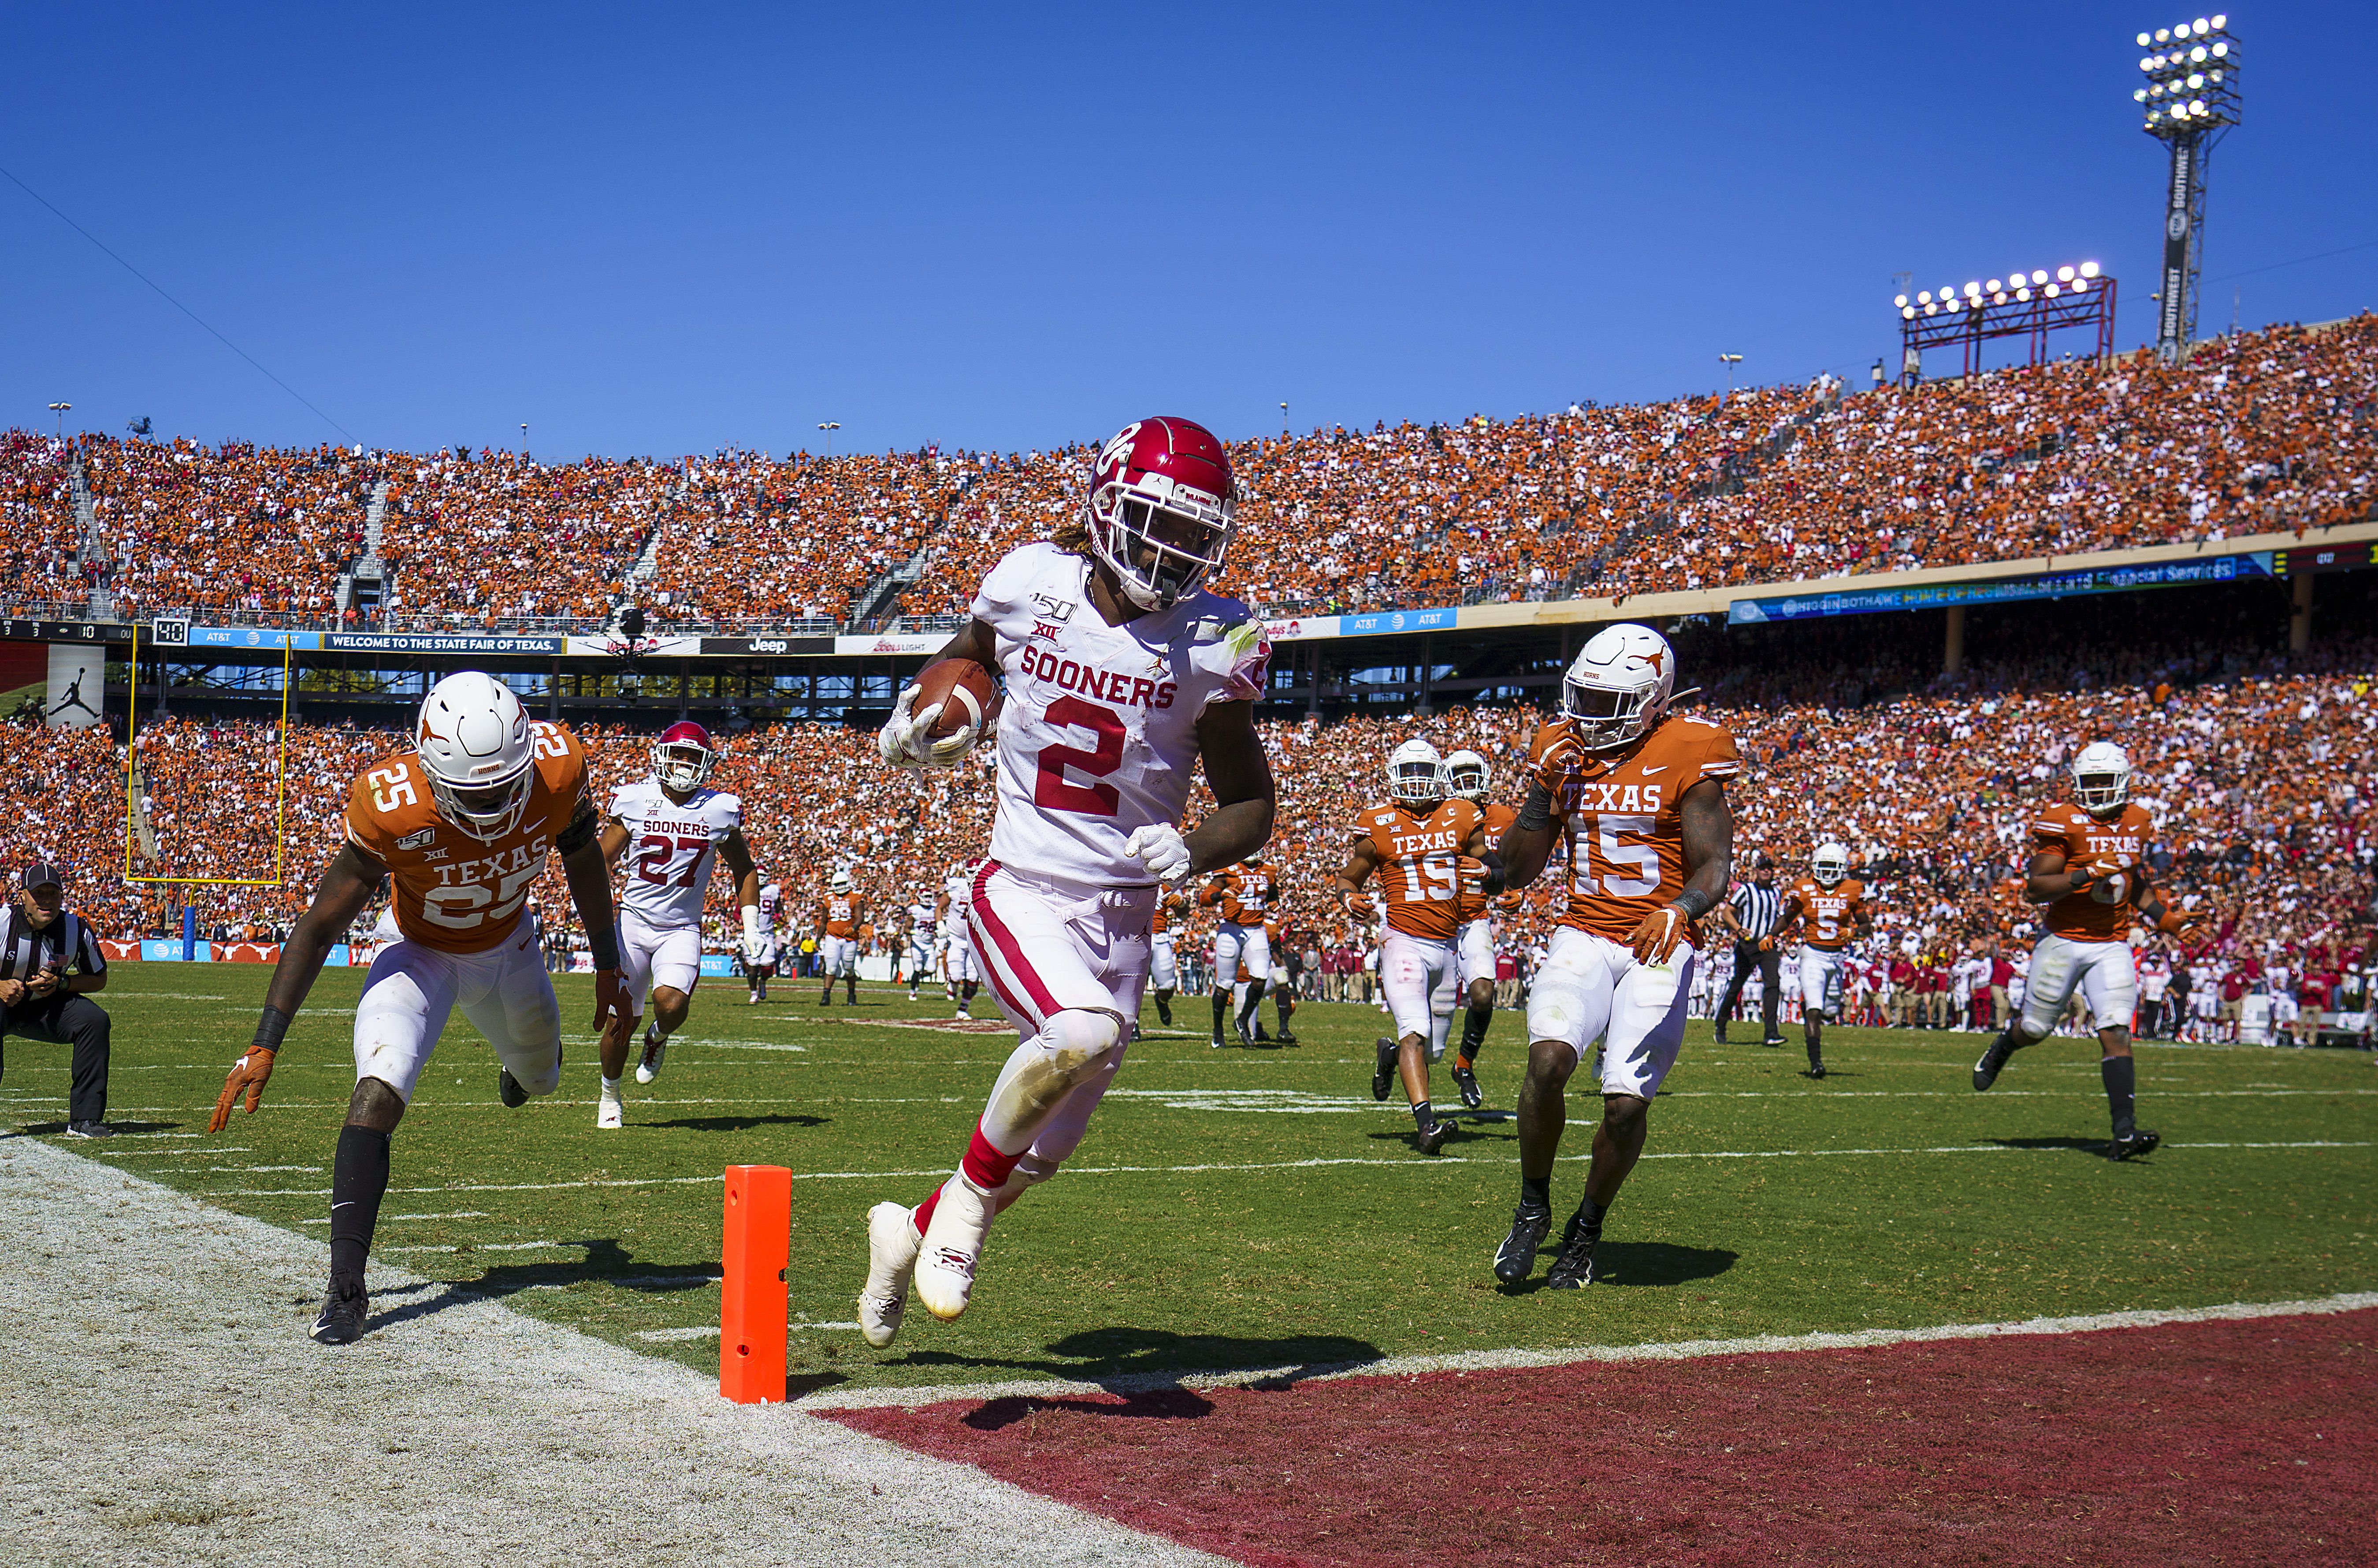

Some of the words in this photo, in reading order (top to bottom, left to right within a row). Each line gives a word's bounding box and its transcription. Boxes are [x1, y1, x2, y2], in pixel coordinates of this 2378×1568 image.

[2163, 267, 2180, 337] SOUTHWEST
[1354, 619, 1377, 629] AT&T
[1418, 613, 1442, 625] AT&T
[5, 626, 10, 635] 3
[33, 628, 39, 637] 3
[83, 626, 94, 638] 10
[159, 623, 183, 641] 40
[207, 633, 231, 642] AT&T
[332, 636, 390, 648] WELCOME
[392, 638, 408, 648] TO
[410, 639, 433, 649] THE
[435, 639, 467, 650] STATE
[469, 639, 495, 650] FAIR
[497, 640, 513, 650] OF
[515, 640, 554, 651] TEXAS.
[749, 639, 787, 654] Jeep
[1021, 645, 1178, 708] SOONERS
[1034, 695, 1126, 817] 2
[478, 765, 500, 775] HORNS
[368, 763, 418, 813] 25
[1562, 784, 1661, 812] TEXAS
[643, 820, 710, 837] SOONERS
[1392, 830, 1456, 854] TEXAS
[2086, 836, 2140, 853] TEXAS
[433, 835, 548, 885] TEXAS
[639, 835, 710, 888] 27
[1568, 814, 1661, 898] 15
[1238, 875, 1268, 884] TEXAS
[1398, 850, 1456, 902] 19
[422, 864, 547, 929] 25
[1810, 898, 1847, 909] TEXAS
[1817, 909, 1839, 940] 5
[700, 961, 722, 970] AT&T
